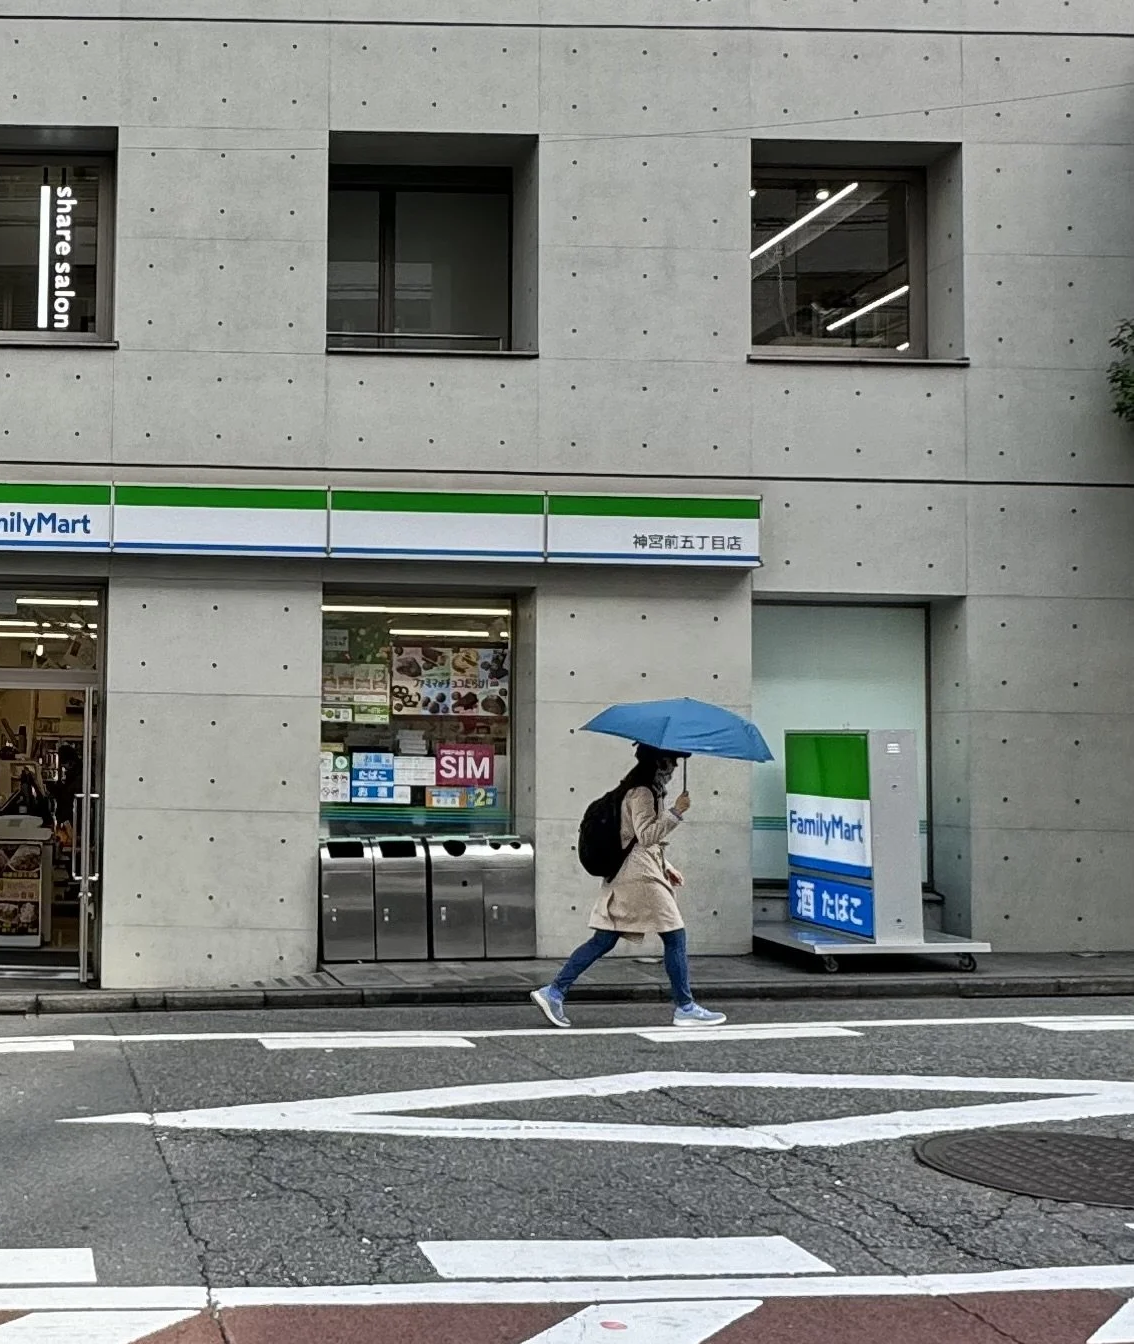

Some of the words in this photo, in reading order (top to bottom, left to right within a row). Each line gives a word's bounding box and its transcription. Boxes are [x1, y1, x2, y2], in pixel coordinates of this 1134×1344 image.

[55, 185, 78, 255] share
[52, 260, 77, 329] salon
[632, 533, 743, 551] 神宮前五丁目店
[358, 769, 388, 781] たばこ
[439, 755, 490, 780] SIM
[789, 809, 864, 846] FamilyMart
[795, 879, 815, 920] 酒
[821, 889, 863, 926] たばこ
